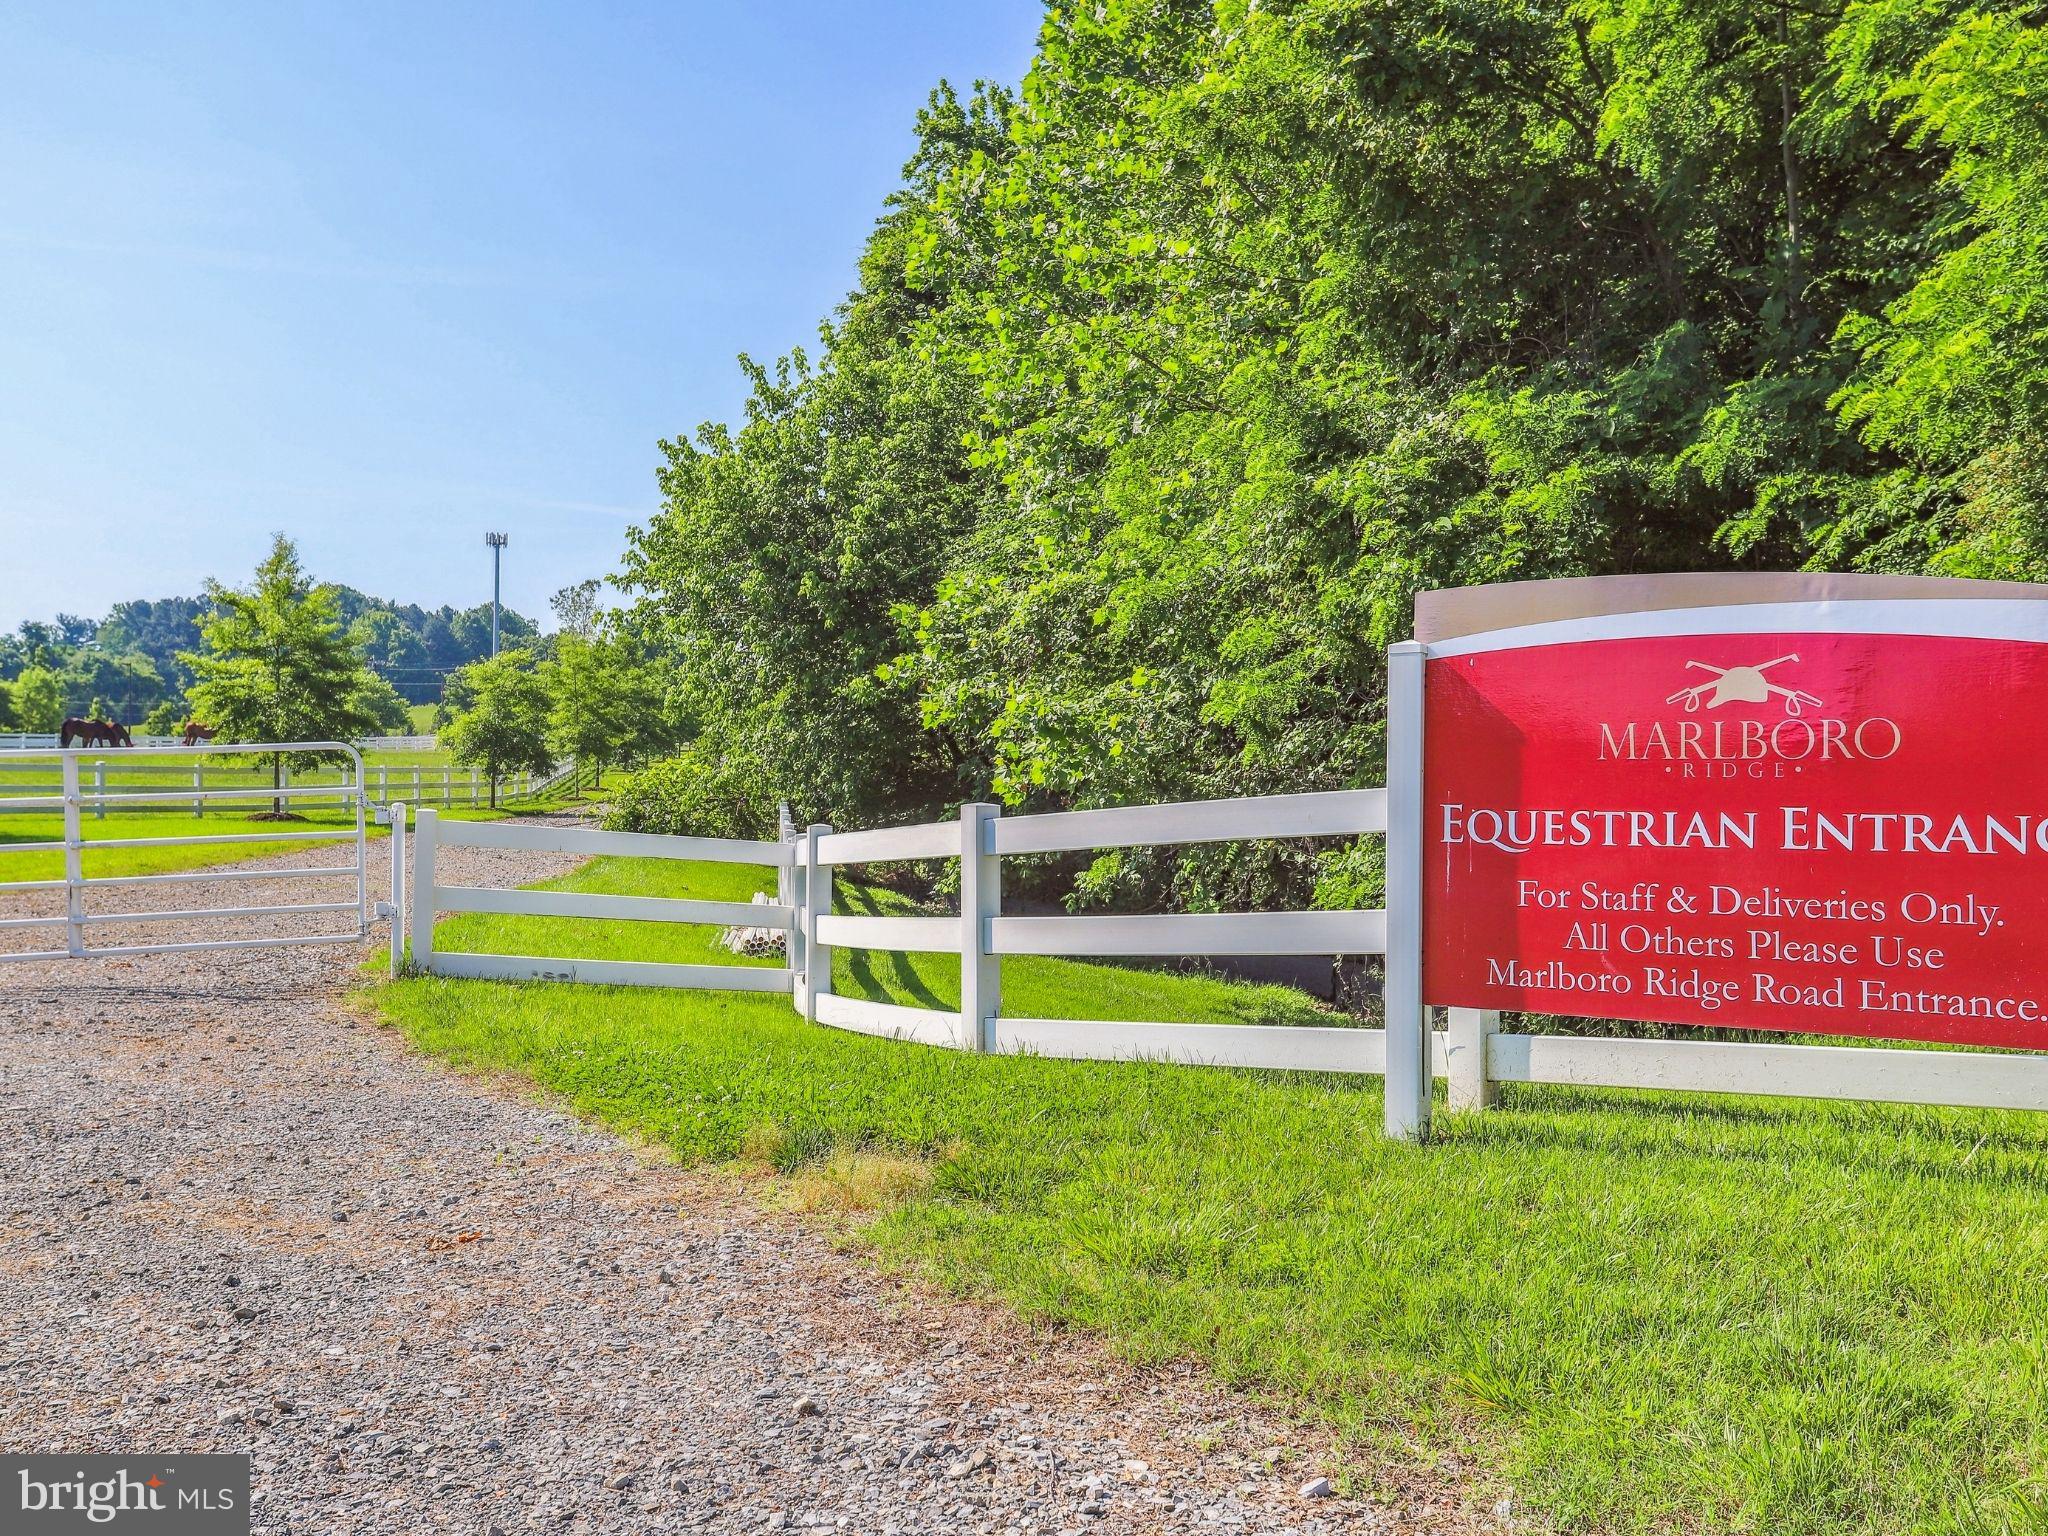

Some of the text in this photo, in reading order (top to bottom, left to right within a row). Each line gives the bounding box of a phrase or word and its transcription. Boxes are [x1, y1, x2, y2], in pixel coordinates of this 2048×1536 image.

[1598, 717, 1902, 761] MARLBORO
[1440, 803, 1756, 853] EQUESTRIAN
[1517, 880, 2005, 936] For Staff & Deliveries Only.
[1564, 922, 1945, 969] All Others Please Use
[1486, 958, 2048, 1022] Marlboro Ridge Road Entrance.
